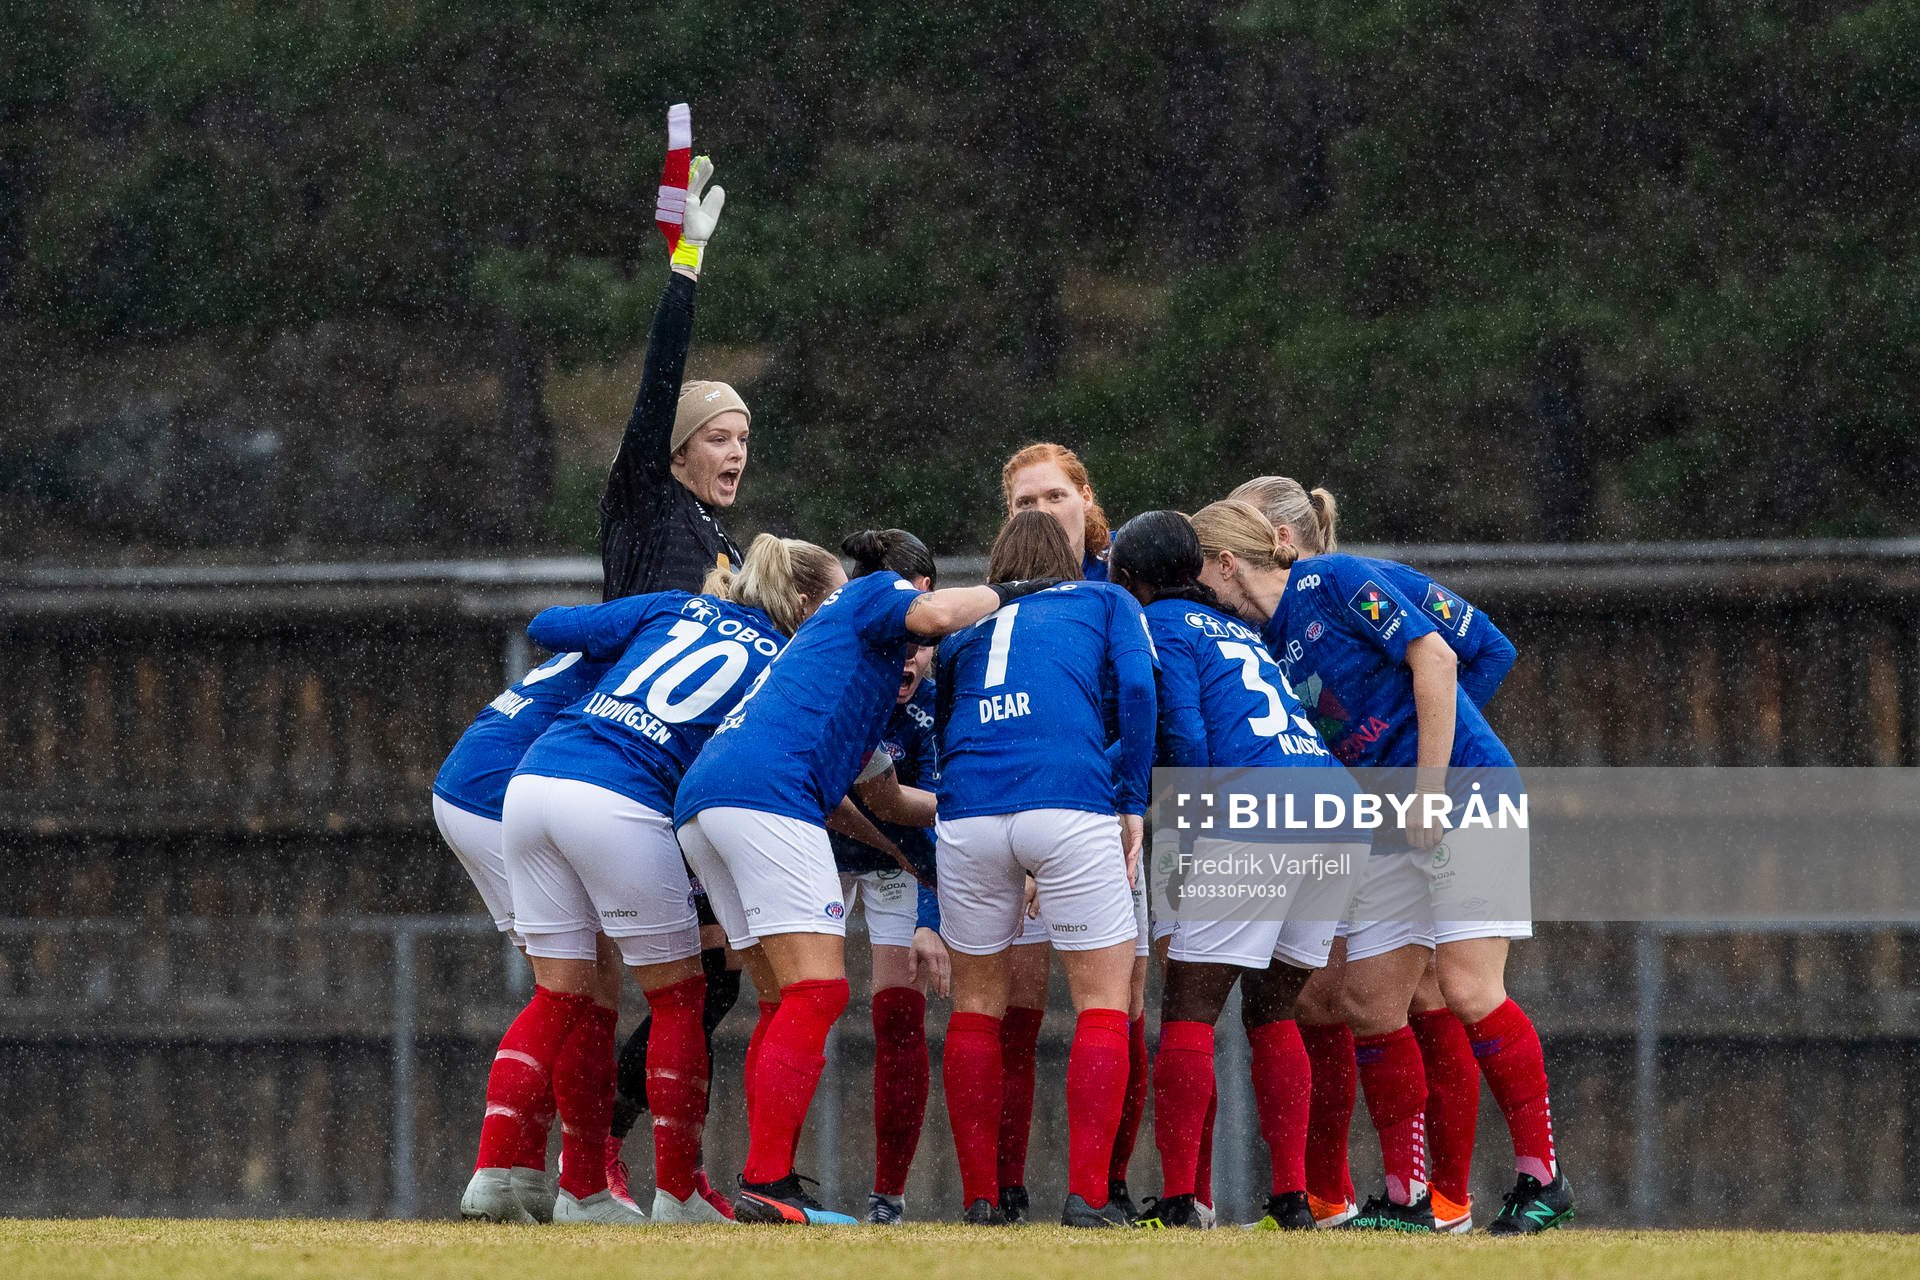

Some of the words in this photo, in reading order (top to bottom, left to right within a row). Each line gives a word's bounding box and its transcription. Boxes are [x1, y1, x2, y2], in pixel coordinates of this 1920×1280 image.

[1457, 604, 1475, 637] umbro
[612, 618, 749, 724] 10
[583, 692, 672, 745] LUDVIGSEN
[979, 691, 1032, 724] DEAR
[601, 908, 638, 919] umbro
[1051, 922, 1089, 933] umbro
[1352, 1217, 1376, 1227] new
[1379, 1215, 1431, 1233] balance
